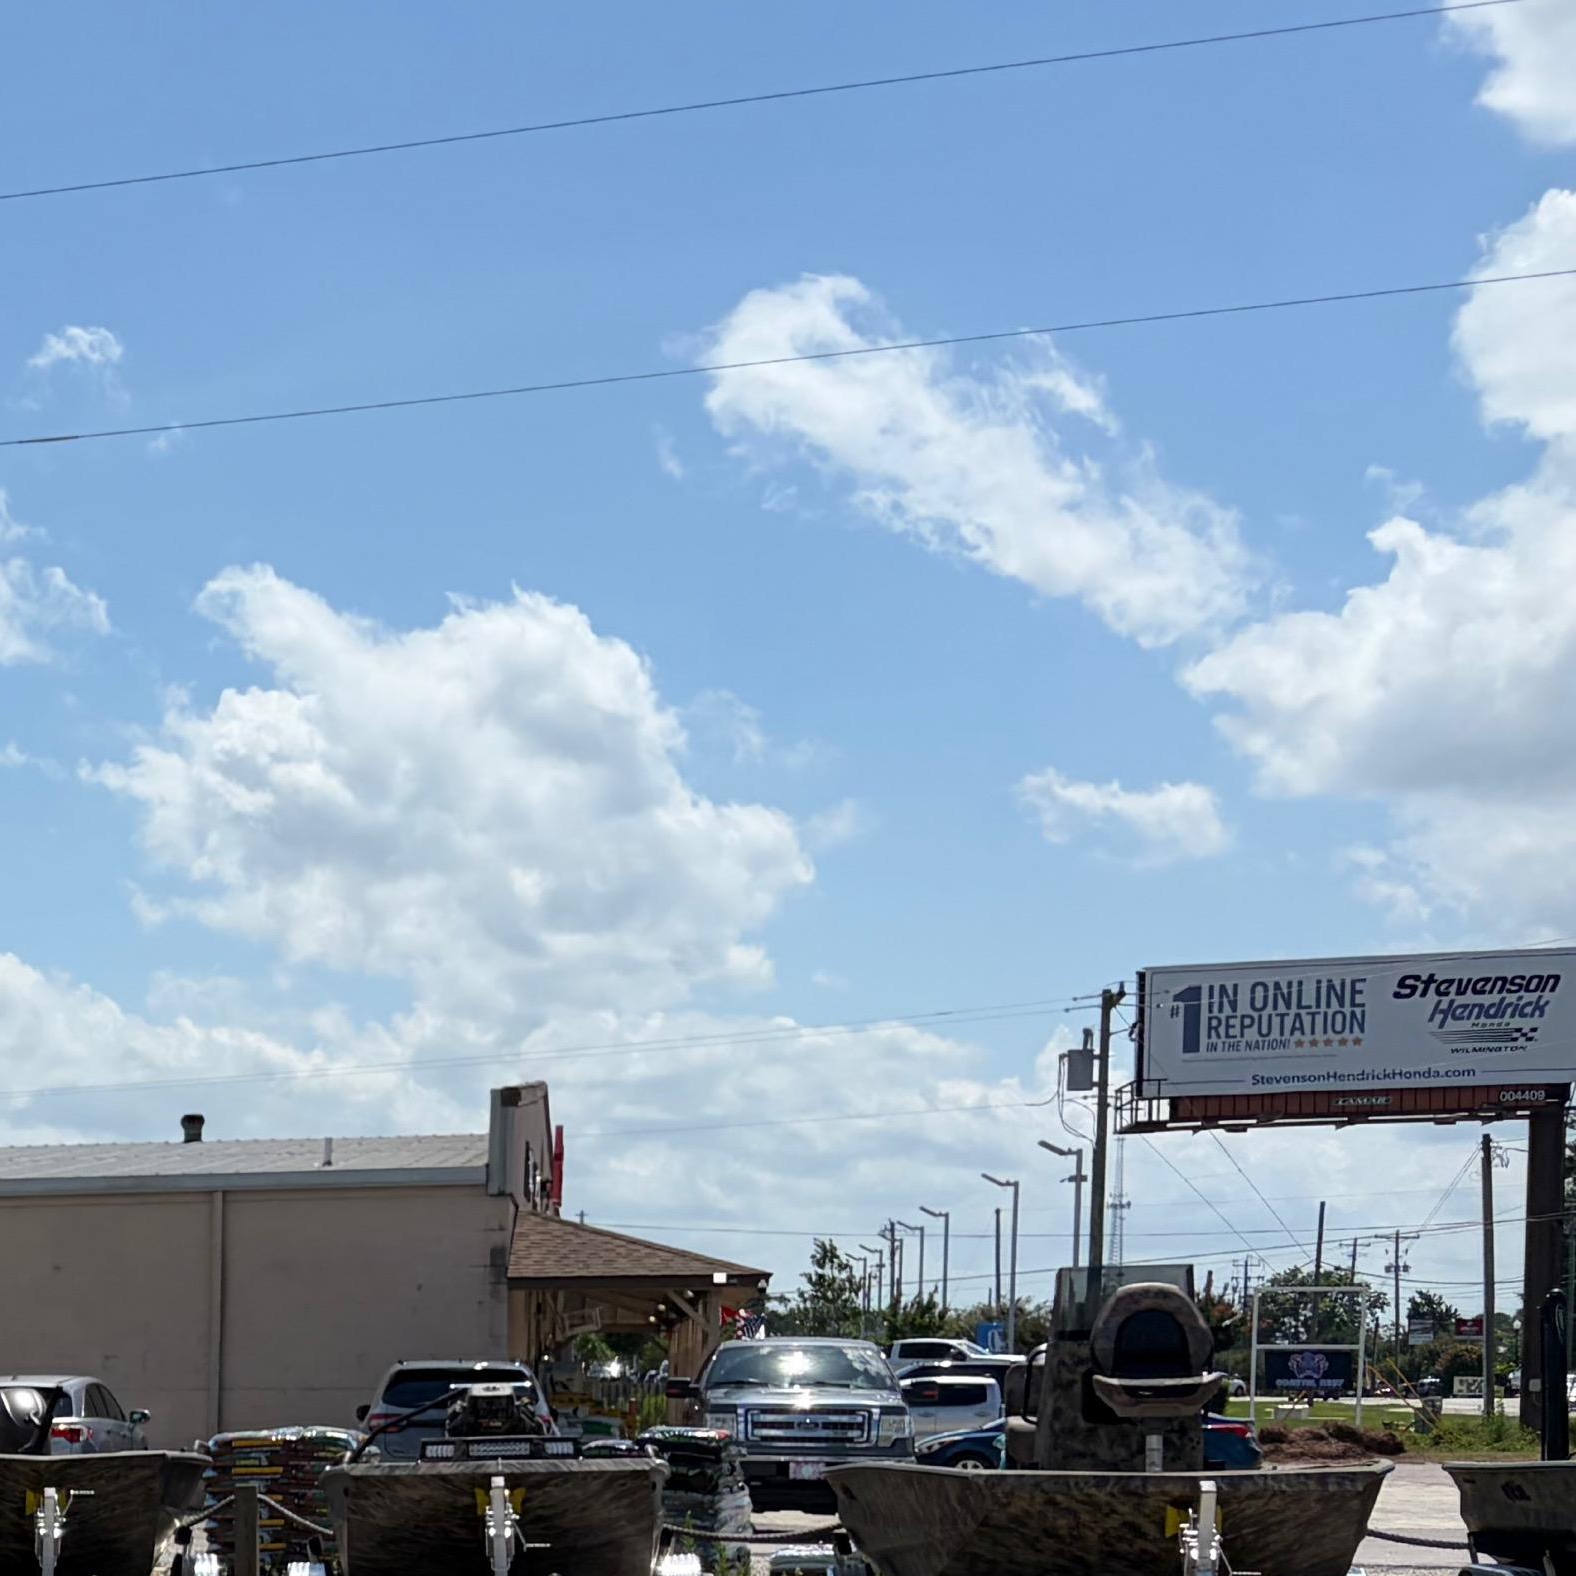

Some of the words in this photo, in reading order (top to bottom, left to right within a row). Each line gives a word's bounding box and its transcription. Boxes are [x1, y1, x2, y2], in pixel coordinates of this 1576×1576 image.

[1208, 984, 1239, 1014] IN
[1249, 978, 1367, 1013] ONLINE
[1392, 973, 1561, 999] Stevenson
[1207, 1010, 1366, 1040] REPUTATION
[1427, 995, 1550, 1029] Hendrick
[1206, 1041, 1220, 1053] IN
[1221, 1040, 1241, 1052] THE
[1247, 1038, 1291, 1051] NATION!
[1450, 1044, 1528, 1054] WILMINGTON
[1251, 1067, 1476, 1086] StevensonHendrickHonda.com
